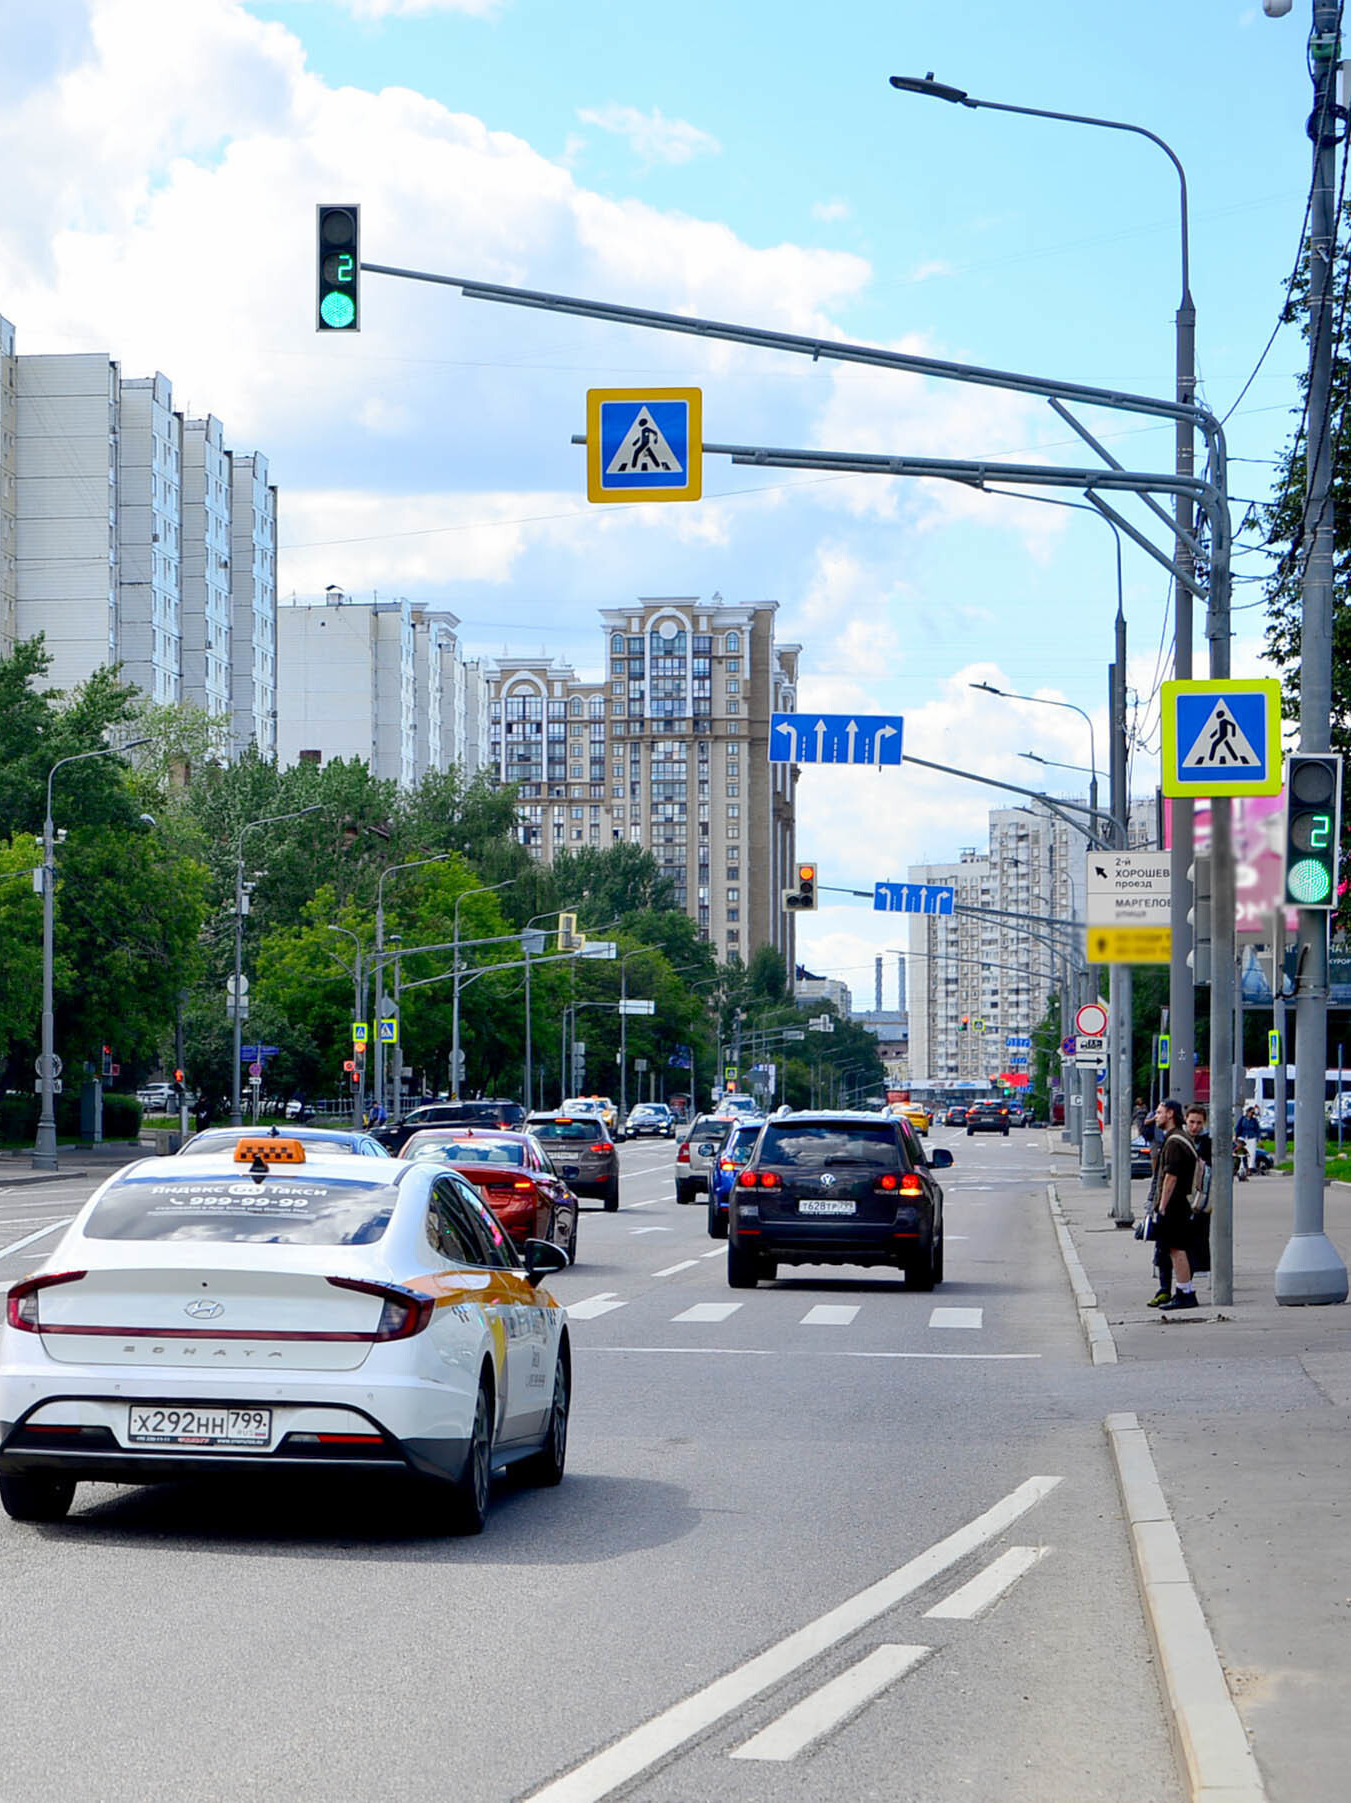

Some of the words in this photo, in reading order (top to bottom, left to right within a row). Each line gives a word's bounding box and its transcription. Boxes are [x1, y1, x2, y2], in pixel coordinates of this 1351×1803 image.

[338, 254, 353, 282] 2
[1311, 815, 1330, 847] 2
[1115, 857, 1131, 866] 2-й
[1115, 881, 1153, 889] проезд
[151, 1185, 225, 1194] Яндекс
[270, 1186, 328, 1197] Такси
[189, 1197, 309, 1208] 999-99-99
[123, 1345, 282, 1358] SONATA
[137, 1411, 225, 1435] Х292НН
[230, 1411, 264, 1429] 799
